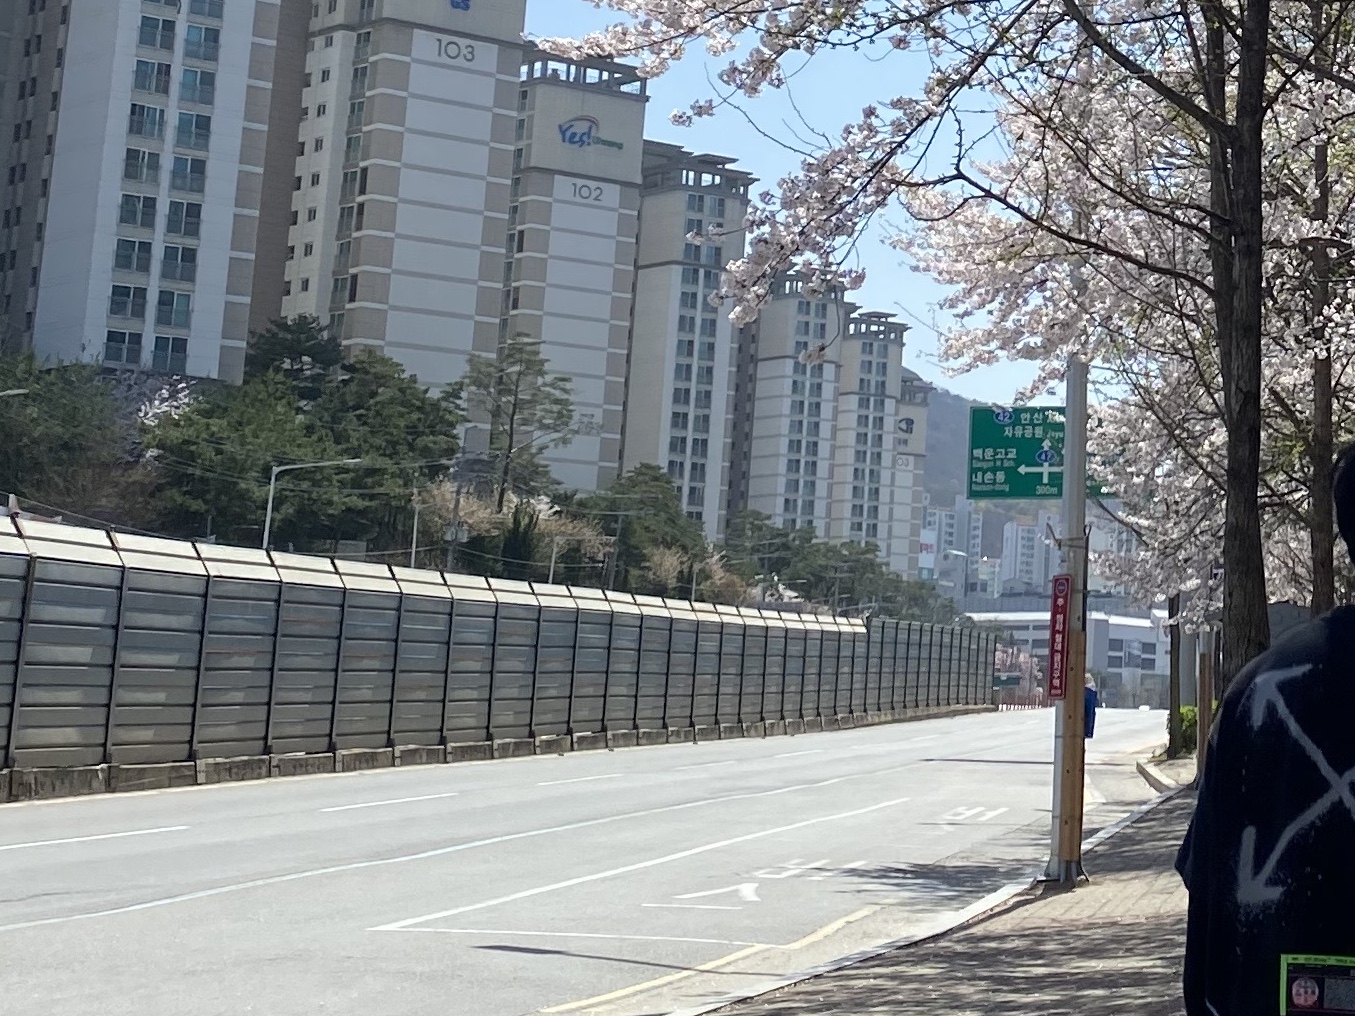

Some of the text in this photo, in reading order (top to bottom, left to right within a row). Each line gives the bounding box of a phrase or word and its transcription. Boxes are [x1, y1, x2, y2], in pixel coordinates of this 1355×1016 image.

[436, 37, 476, 63] 103
[557, 123, 593, 148] Yes!
[571, 182, 603, 203] 102
[1003, 426, 1043, 439] 자유공원
[972, 448, 1017, 460] 백운고교
[972, 471, 1006, 483] 내손동
[1035, 485, 1058, 495] 300m
